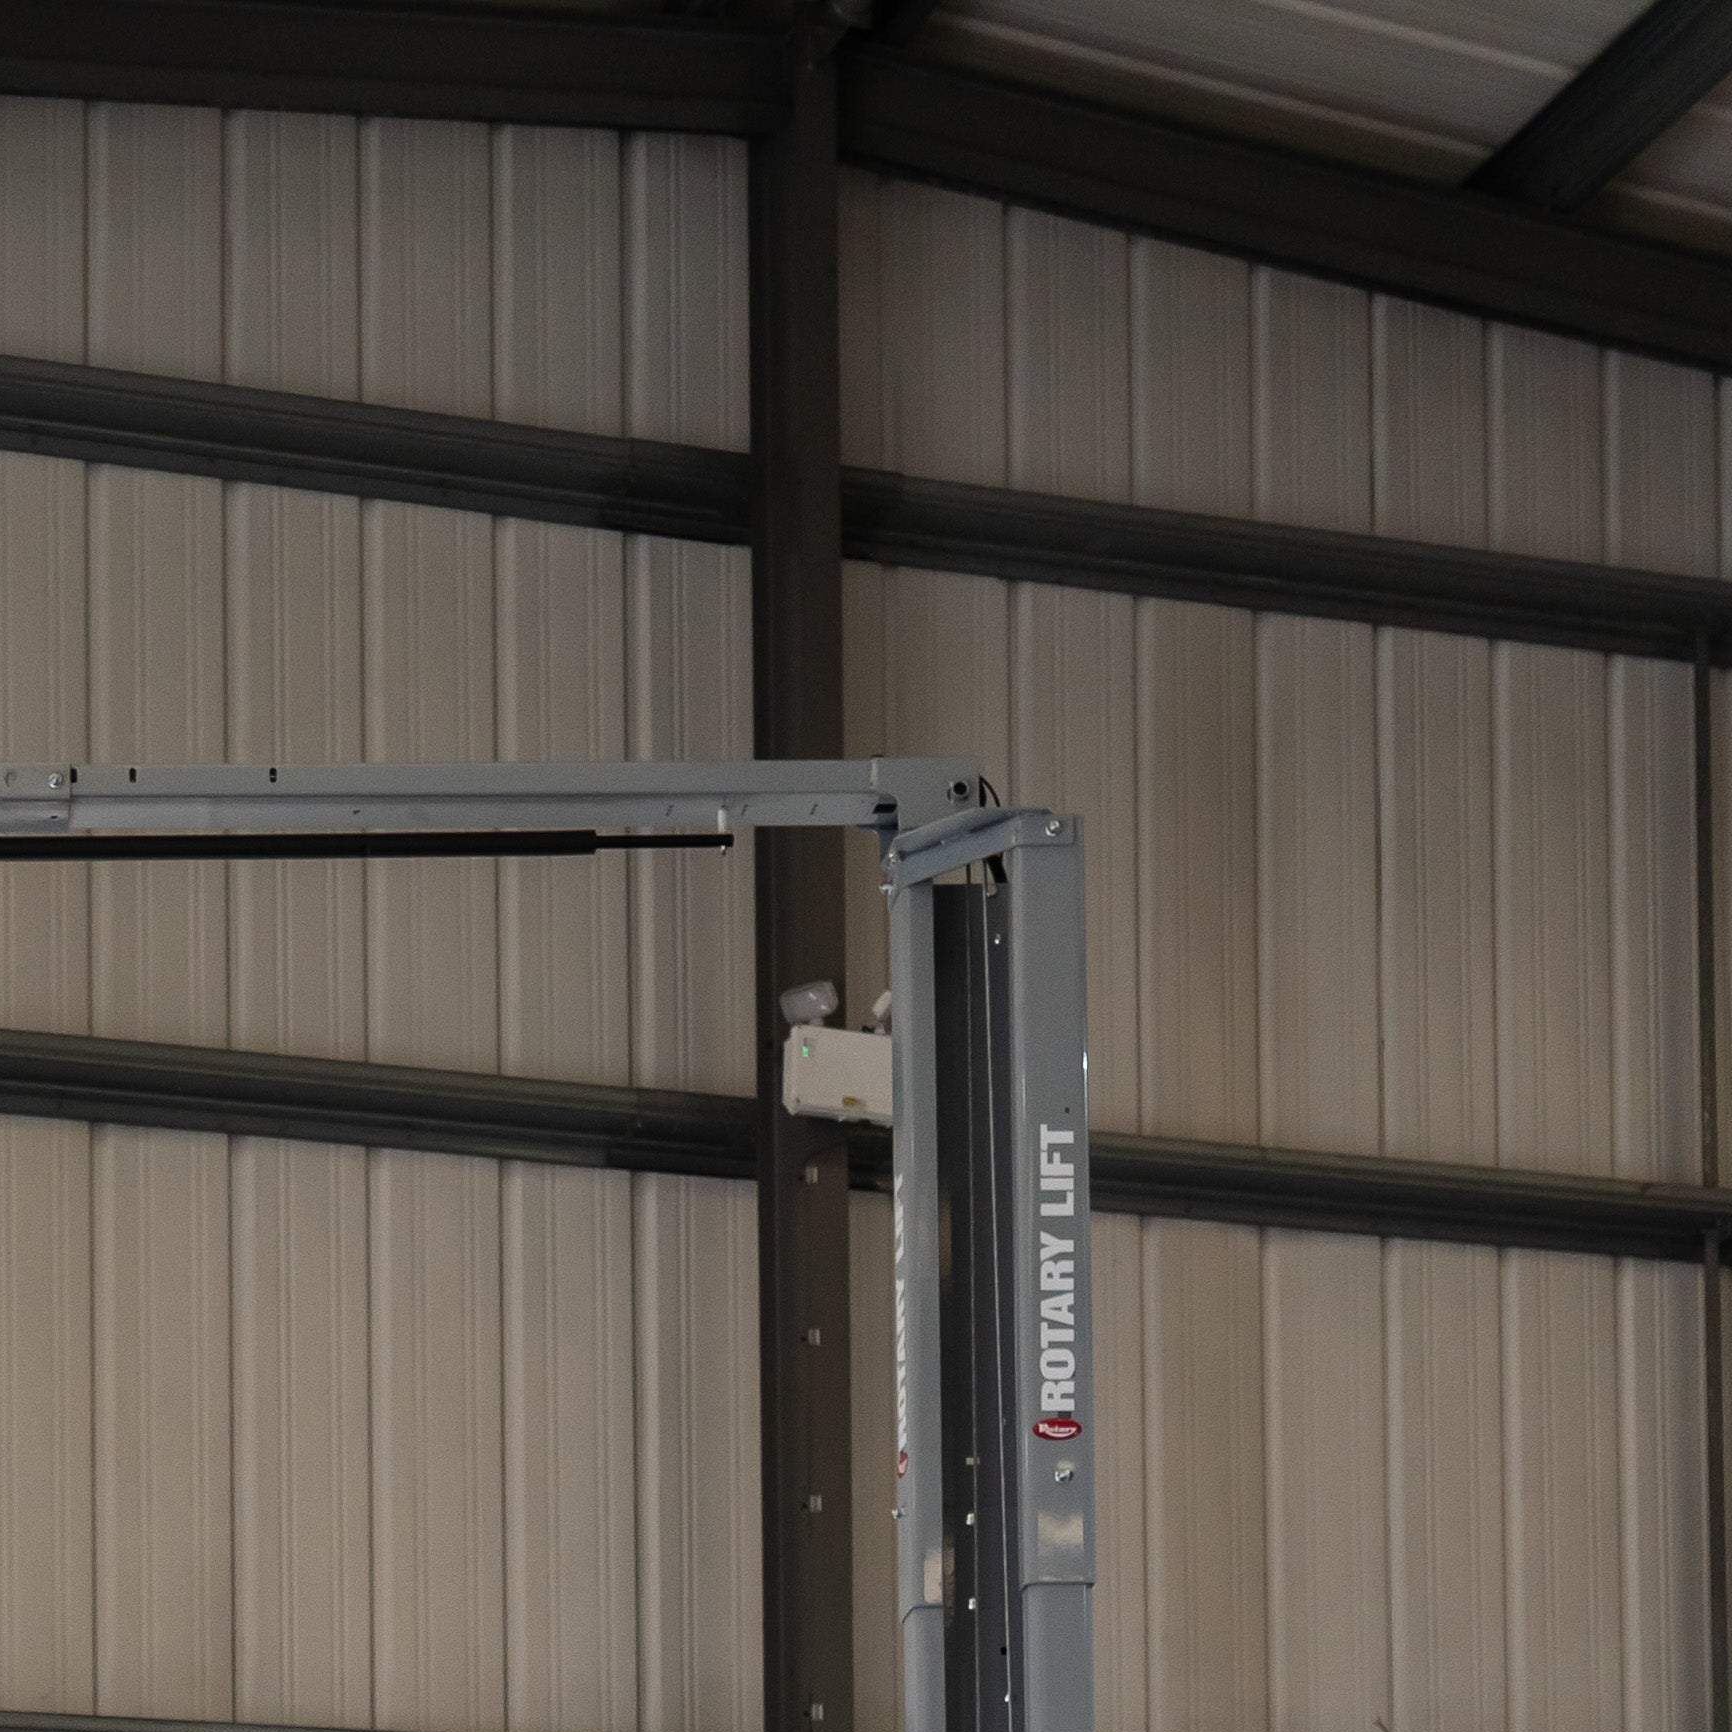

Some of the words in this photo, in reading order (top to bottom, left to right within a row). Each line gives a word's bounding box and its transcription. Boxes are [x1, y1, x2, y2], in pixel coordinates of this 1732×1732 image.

[1039, 1124, 1075, 1217] LIFT
[1039, 1231, 1076, 1412] ROTARY
[1038, 1422, 1077, 1438] Rotary
